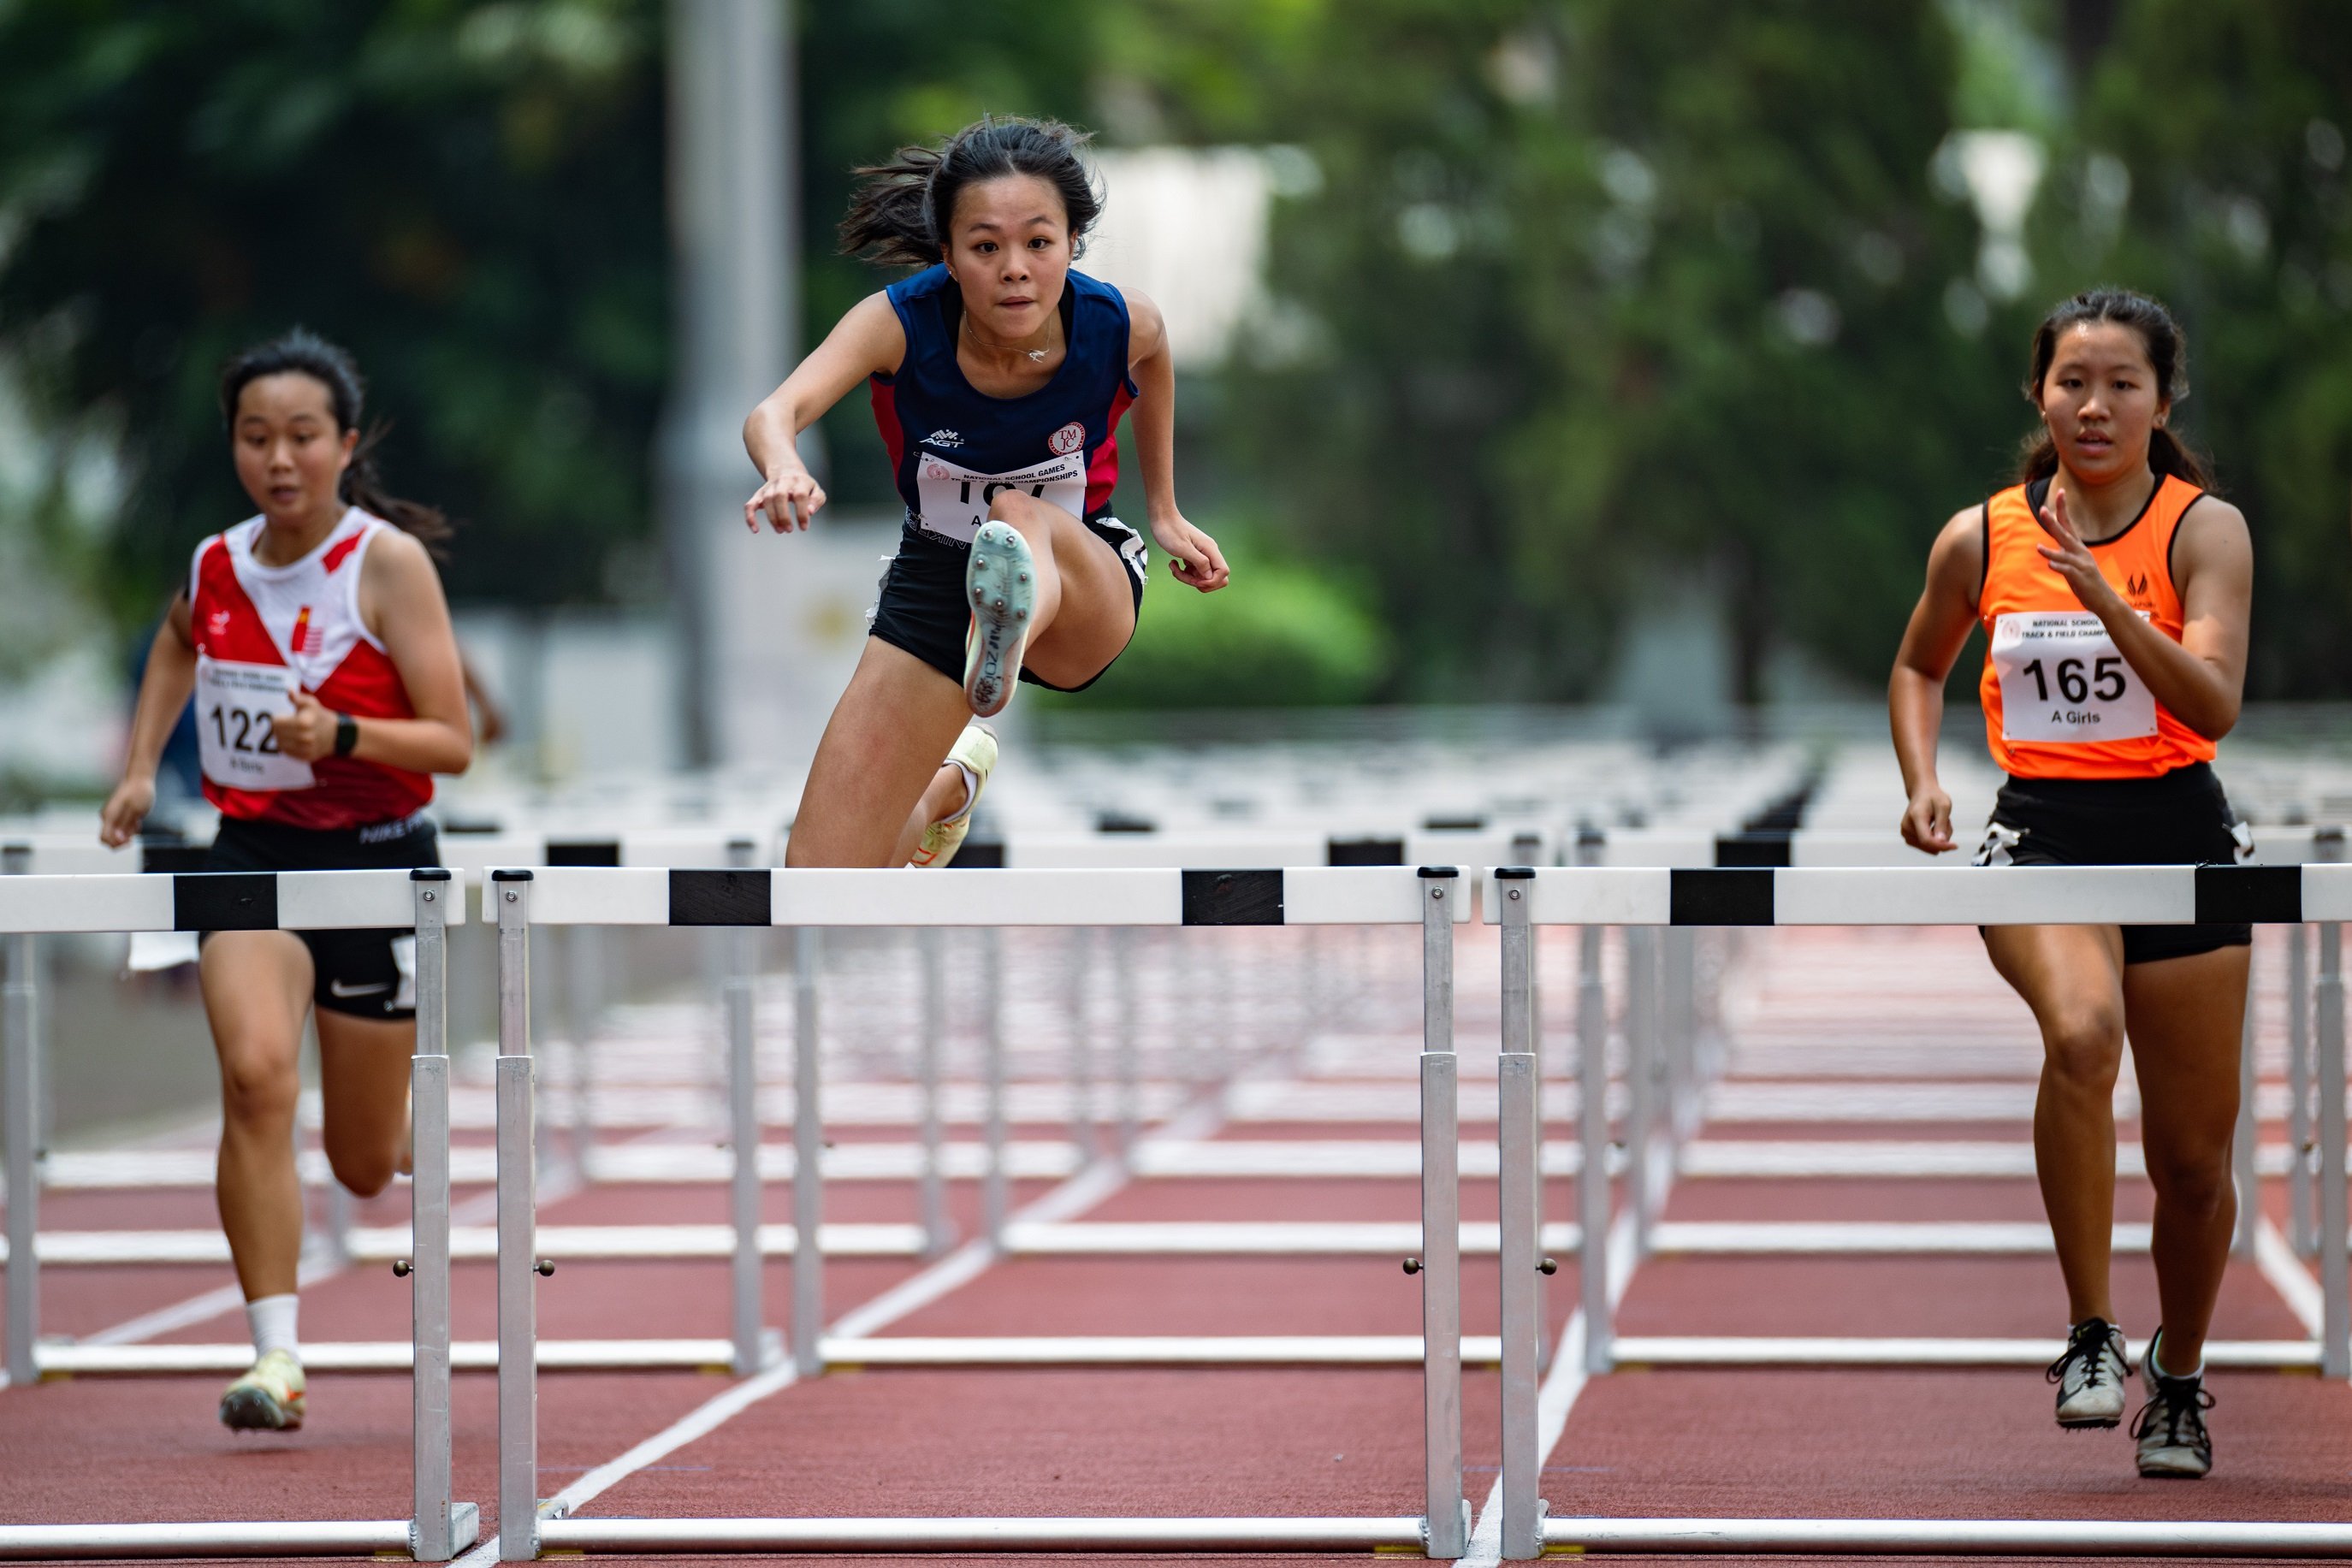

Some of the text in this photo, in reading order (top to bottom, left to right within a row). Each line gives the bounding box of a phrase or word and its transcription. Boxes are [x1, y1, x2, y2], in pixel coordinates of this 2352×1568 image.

[1059, 429, 1076, 439] TM
[919, 438, 964, 448] AGT
[1061, 438, 1074, 451] JC
[1038, 464, 1066, 476] GAMES
[1011, 470, 1079, 484] CHAMPIONSHIPS
[2023, 657, 2127, 704] 165
[2052, 710, 2101, 724] A Girls
[210, 703, 281, 755] 122
